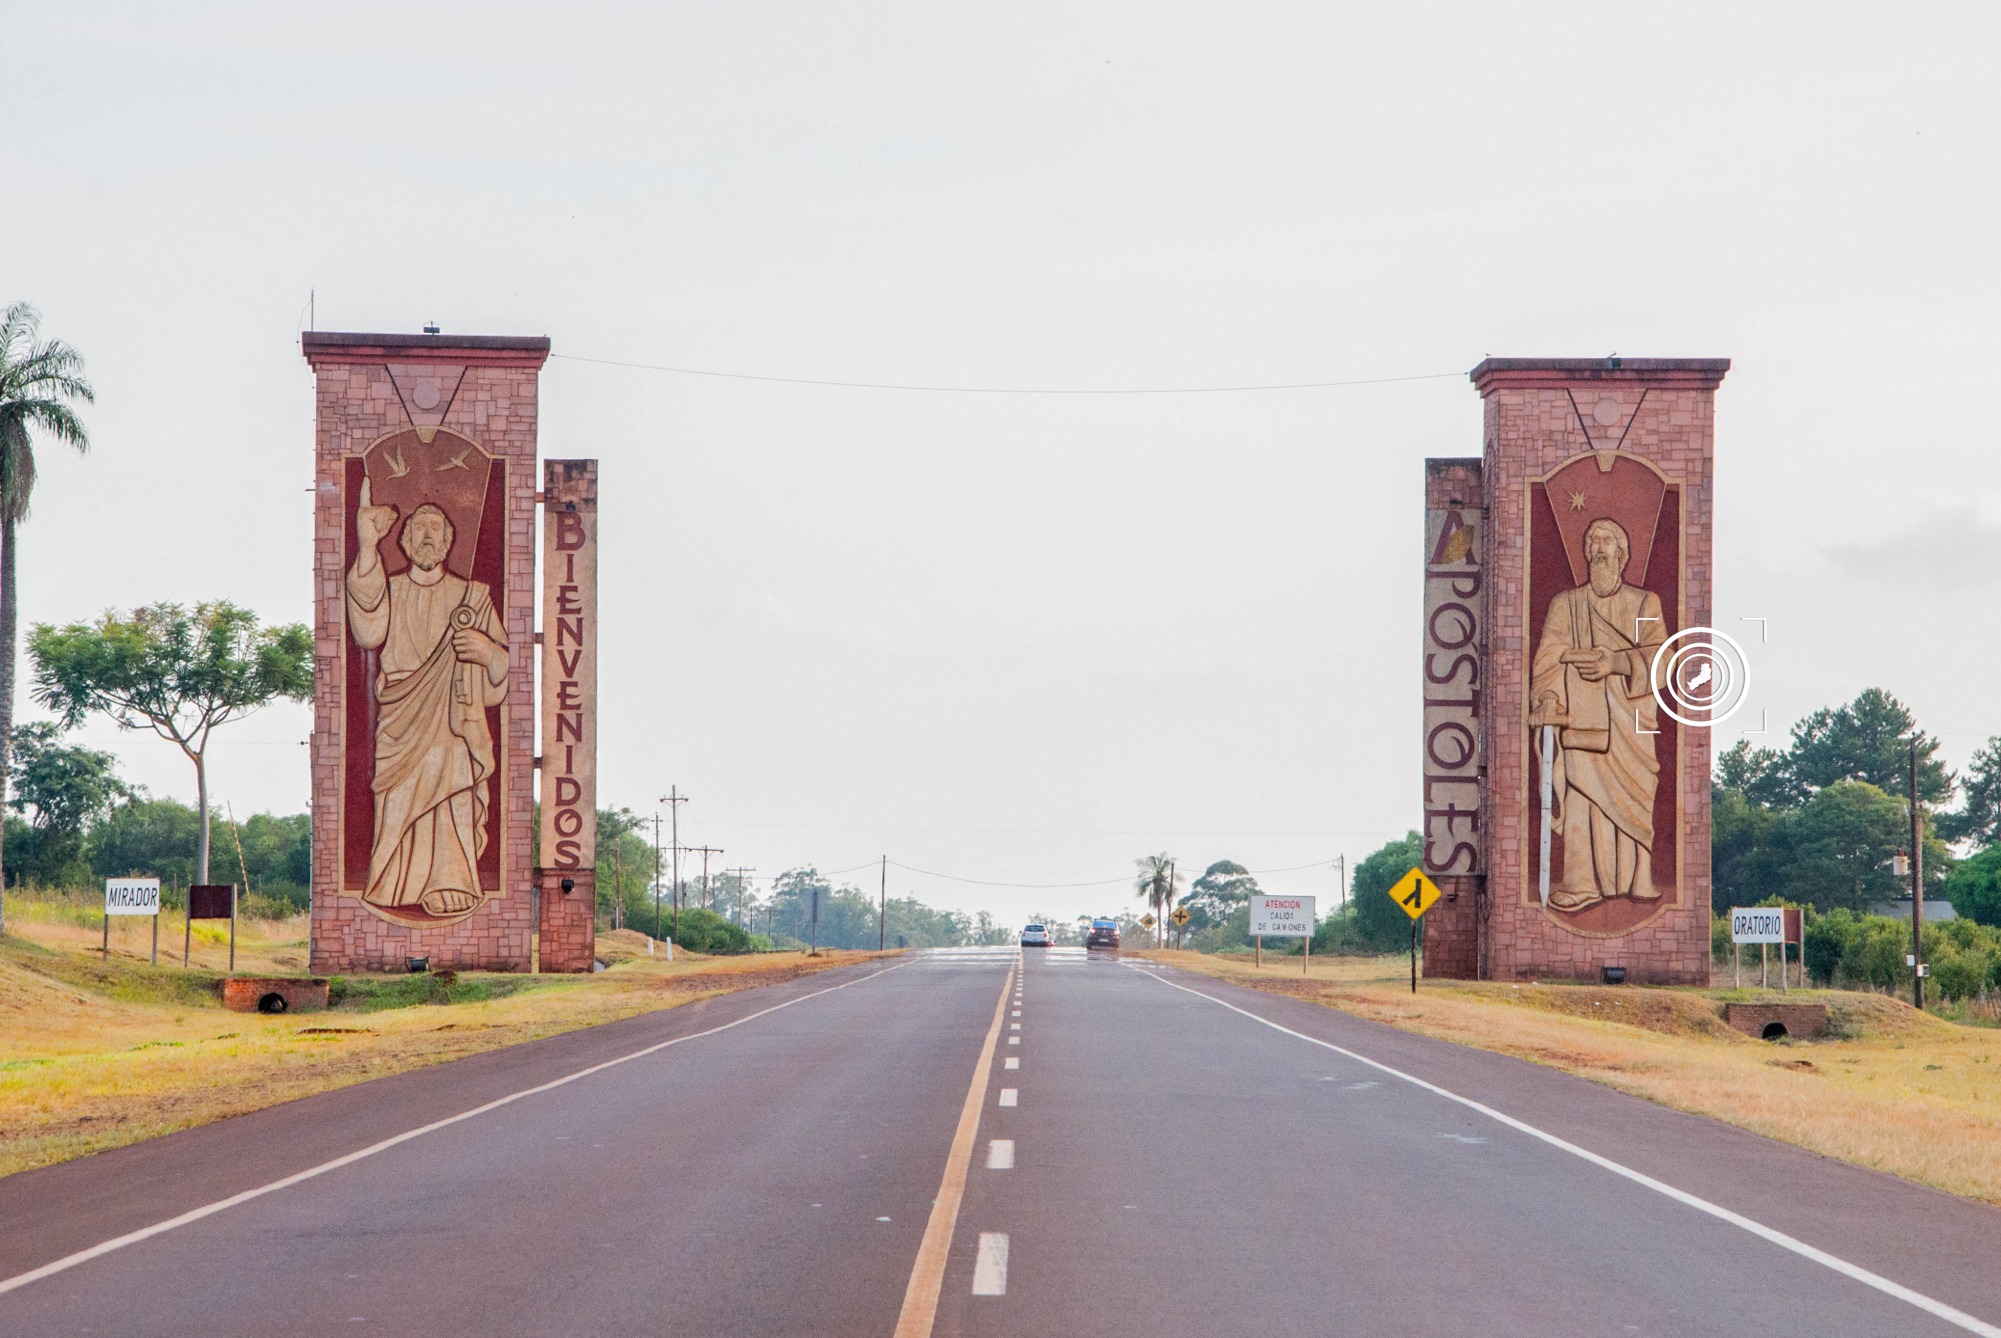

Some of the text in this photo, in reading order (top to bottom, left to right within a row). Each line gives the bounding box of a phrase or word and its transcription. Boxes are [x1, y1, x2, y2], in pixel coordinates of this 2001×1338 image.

[554, 512, 586, 869] BIENVENIDOS
[1424, 510, 1481, 872] APOSTOLES
[108, 887, 158, 907] MIRADOR
[1265, 899, 1301, 909] ATENCION
[1258, 923, 1267, 931] DE
[1734, 915, 1781, 935] ORATORIO
